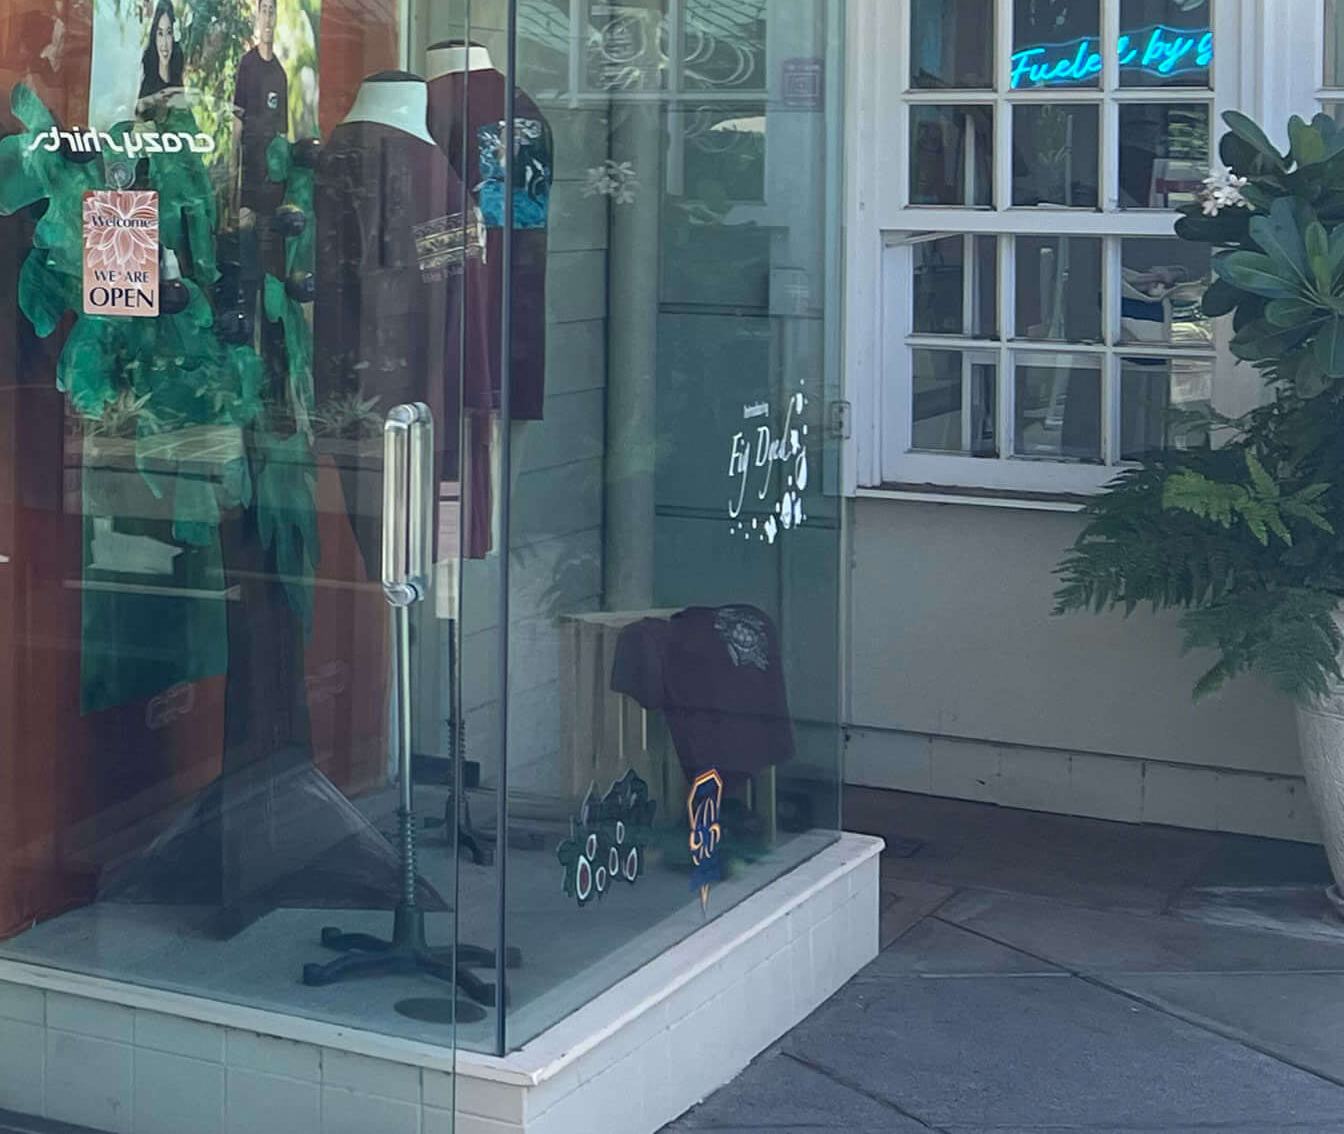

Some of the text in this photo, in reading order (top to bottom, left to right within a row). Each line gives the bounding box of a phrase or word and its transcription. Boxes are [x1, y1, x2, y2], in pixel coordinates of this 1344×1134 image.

[1141, 28, 1195, 73] by
[90, 216, 152, 228] Welcome
[94, 269, 150, 283] WE ARE
[89, 287, 154, 308] OPEN
